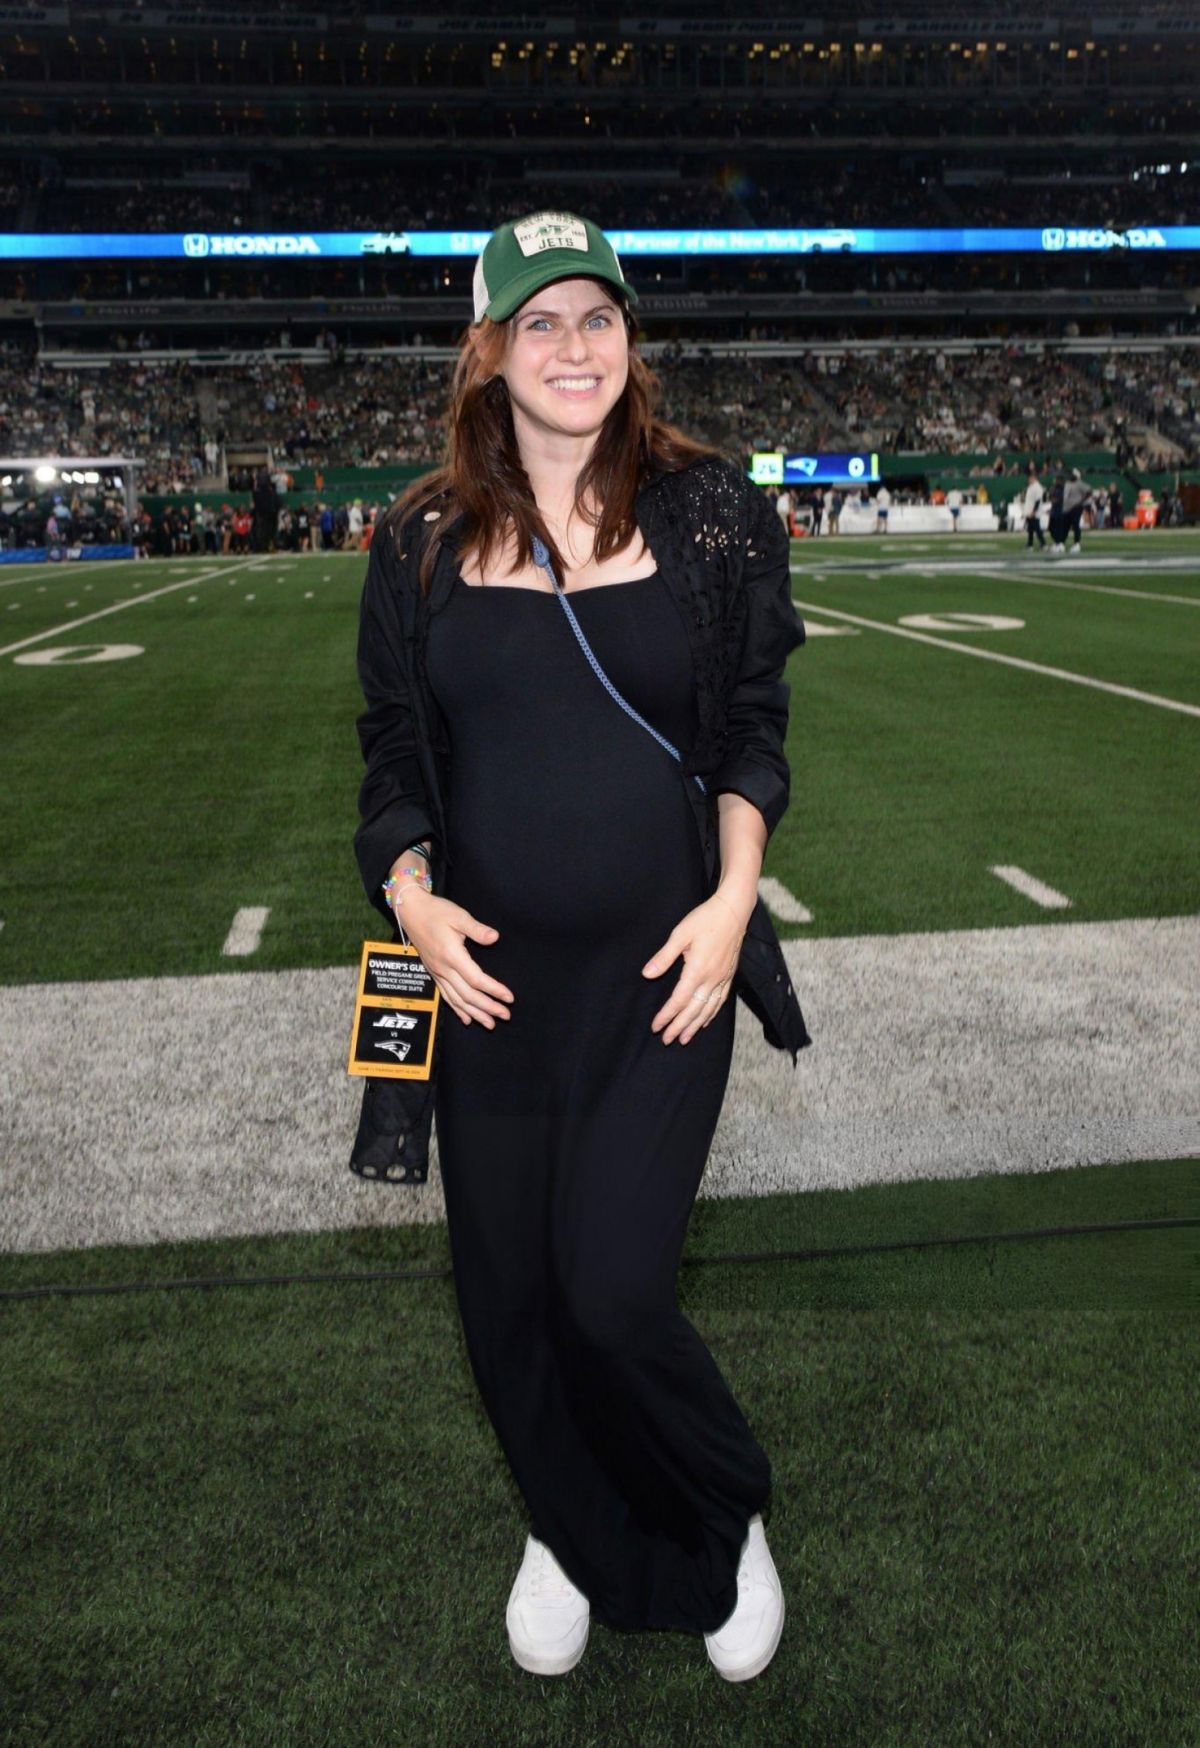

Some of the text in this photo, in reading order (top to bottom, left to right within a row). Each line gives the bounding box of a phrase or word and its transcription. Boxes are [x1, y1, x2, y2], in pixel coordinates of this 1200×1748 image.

[210, 236, 320, 254] HONDA
[539, 237, 574, 249] JETS
[624, 233, 681, 250] Partner
[684, 233, 701, 252] of
[701, 233, 726, 250] the
[730, 233, 764, 250] New
[766, 233, 800, 250] York
[1066, 229, 1167, 248] HONDA
[848, 457, 865, 478] 0
[369, 959, 426, 972] OWNER'S GUE
[373, 1012, 418, 1030] JETS
